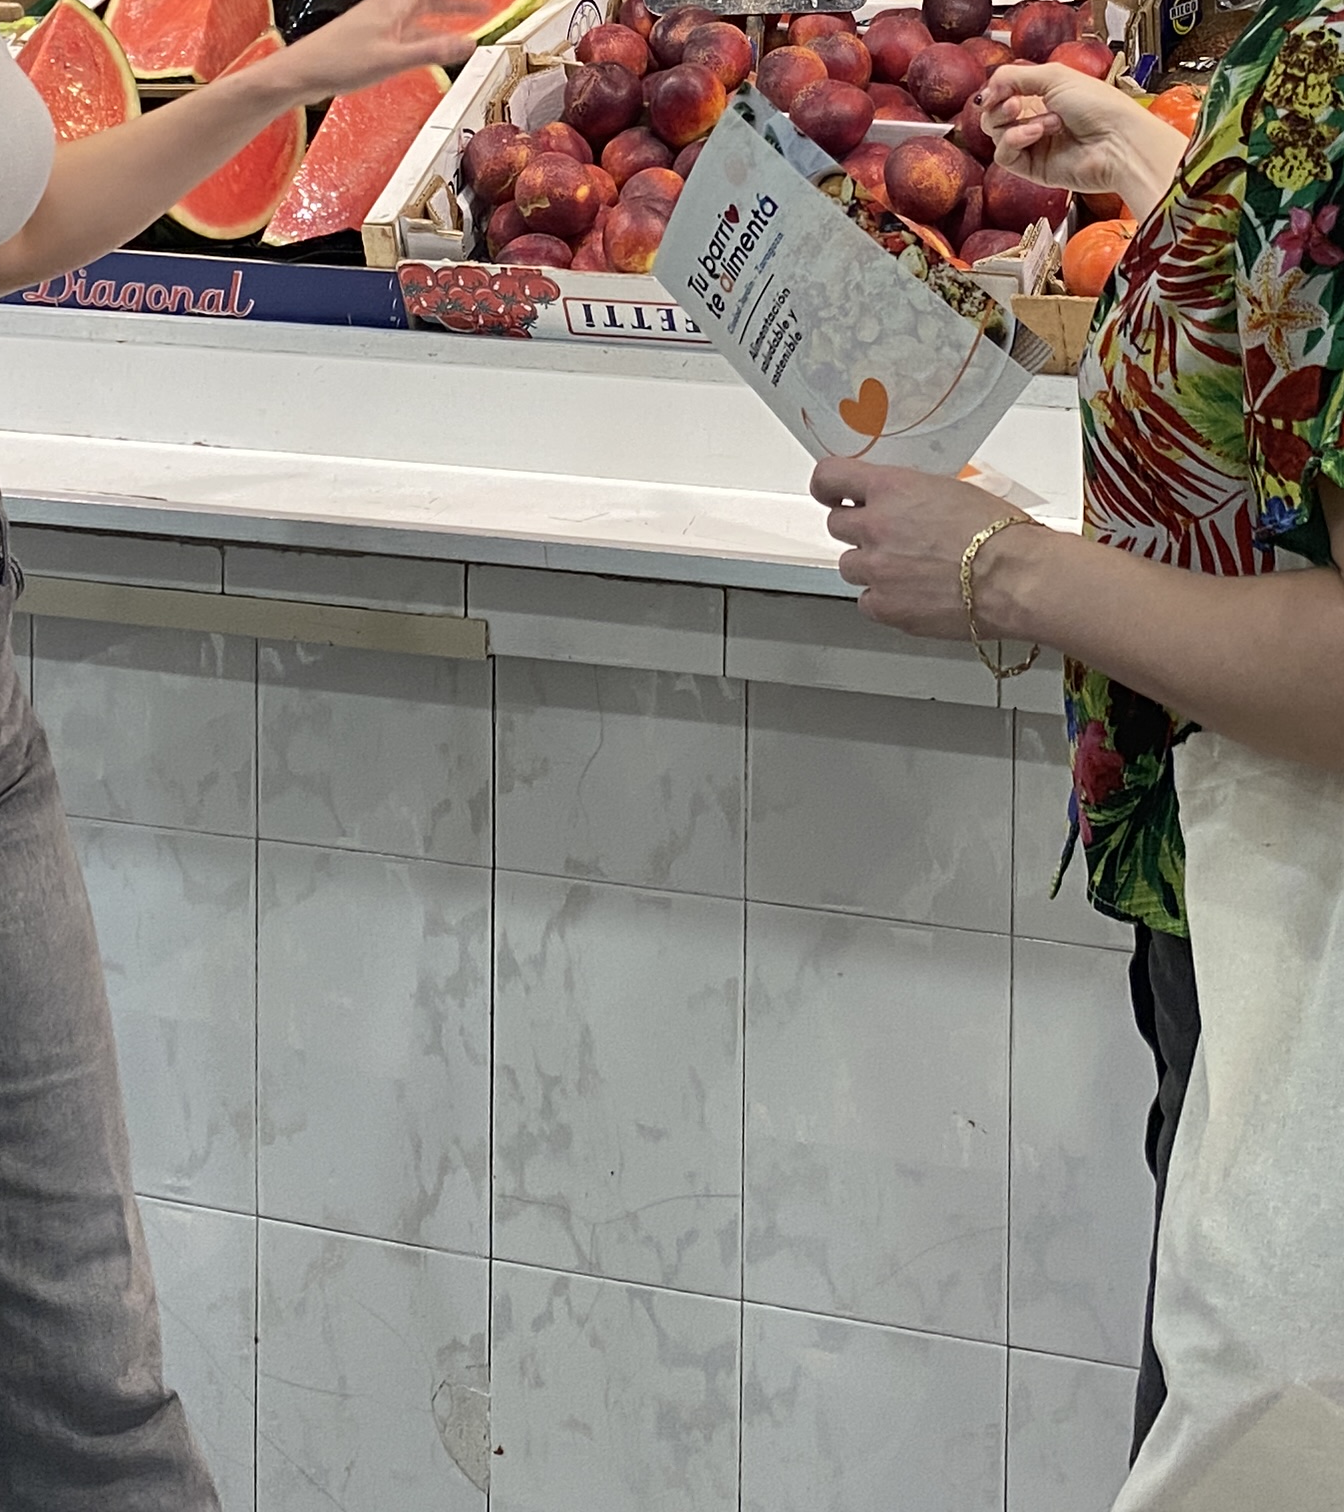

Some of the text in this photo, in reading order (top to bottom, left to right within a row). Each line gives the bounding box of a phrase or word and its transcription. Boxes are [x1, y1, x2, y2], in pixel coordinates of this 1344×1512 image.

[1171, 0, 1197, 18] RIEGO
[22, 270, 255, 320] Diagonal
[687, 273, 709, 299] Tu
[706, 293, 726, 320] te
